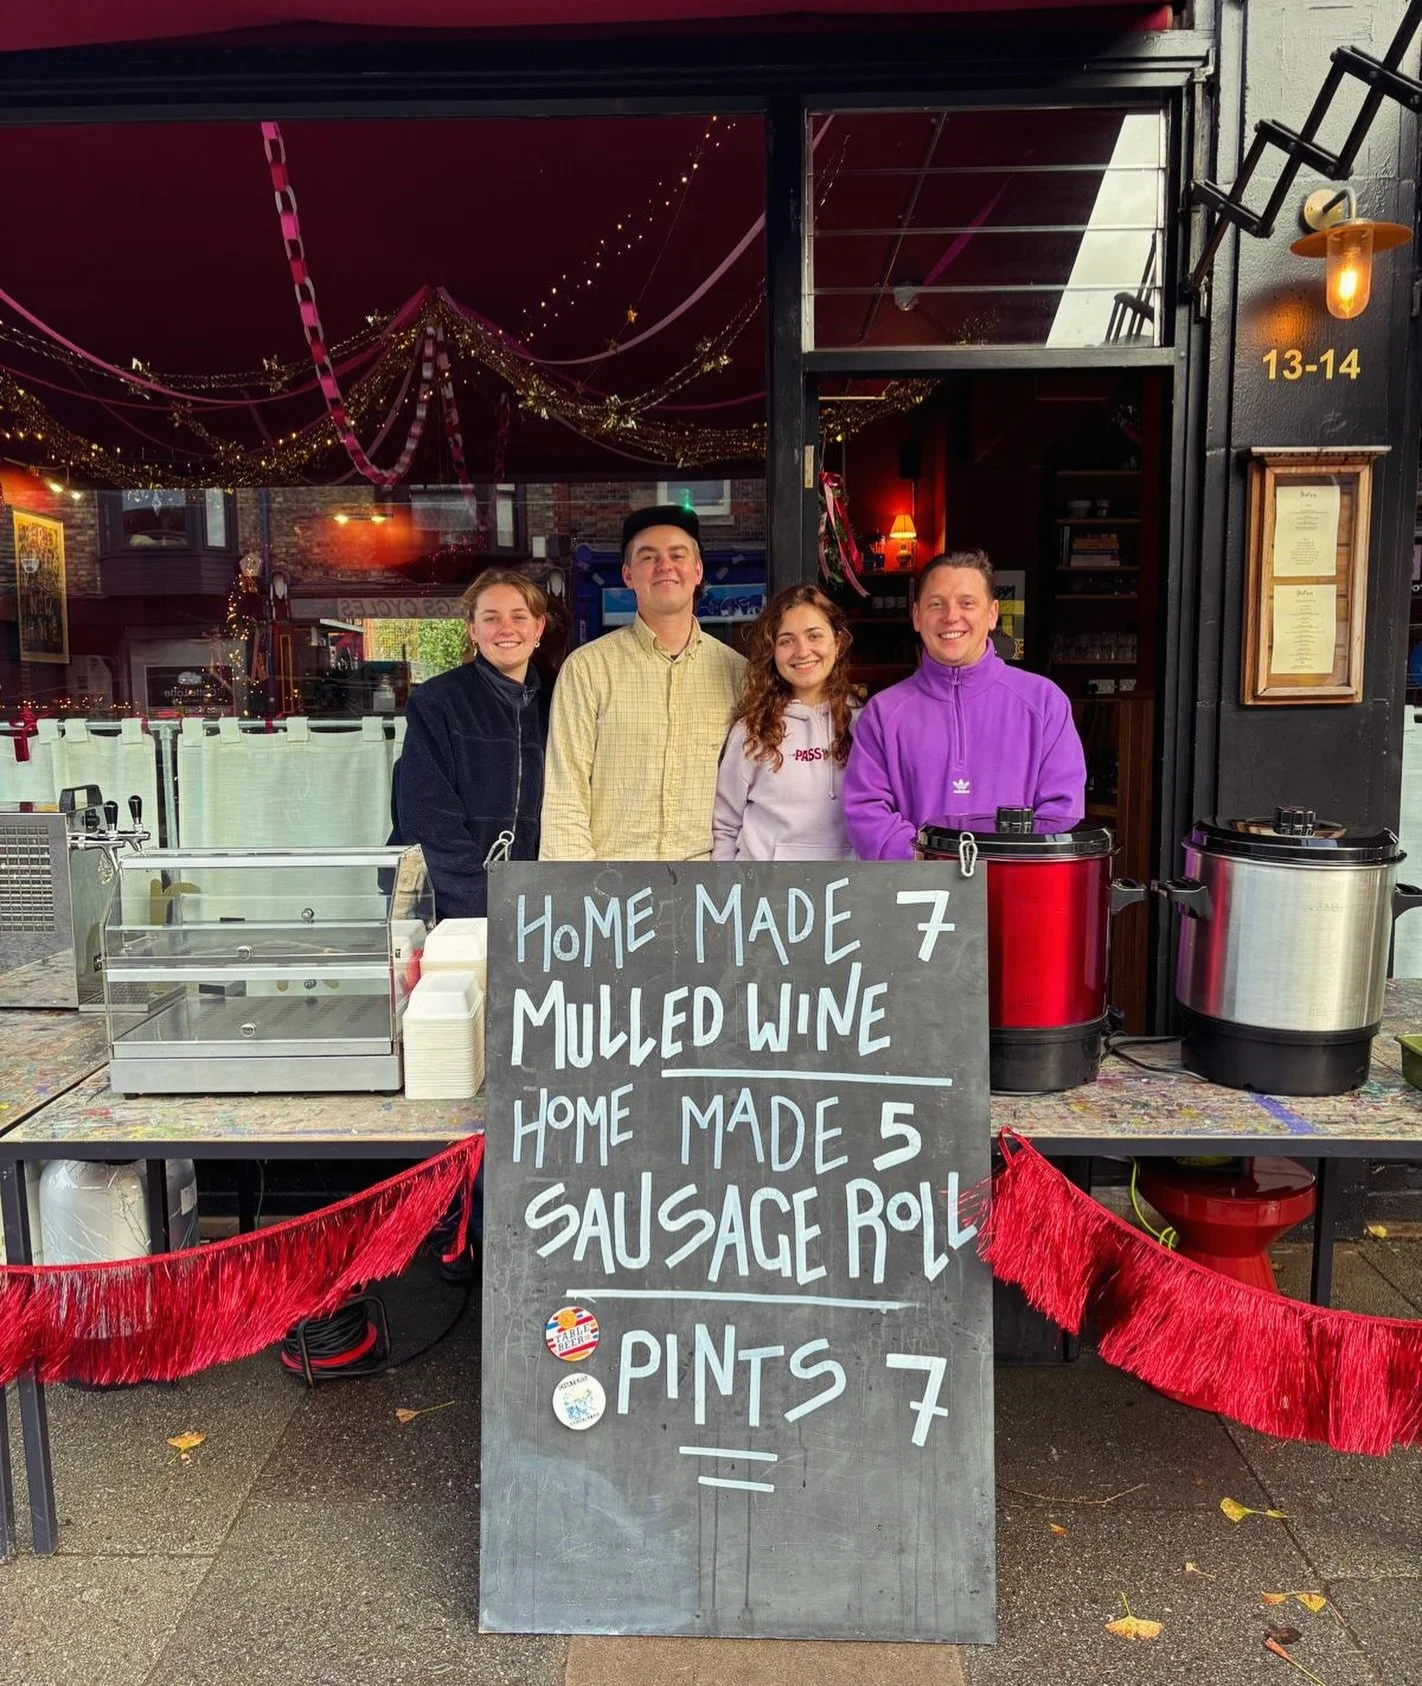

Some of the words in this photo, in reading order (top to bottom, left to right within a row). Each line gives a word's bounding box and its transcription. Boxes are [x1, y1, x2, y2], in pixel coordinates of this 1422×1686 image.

[1262, 348, 1360, 380] 13-14
[518, 887, 655, 972] HOME
[696, 878, 860, 966] MADE
[896, 890, 955, 962] 7
[511, 980, 723, 1069] MULLED
[748, 962, 890, 1056] WINE
[513, 1083, 633, 1168] HOME
[682, 1088, 848, 1174] MADE
[873, 1102, 921, 1171] 5
[525, 1167, 830, 1285] SAUSAGE
[846, 1172, 977, 1284] ROLL
[555, 1323, 590, 1344] TABLE
[558, 1335, 584, 1352] BEER
[618, 1324, 846, 1427] PINTS
[886, 1354, 948, 1447] 7
